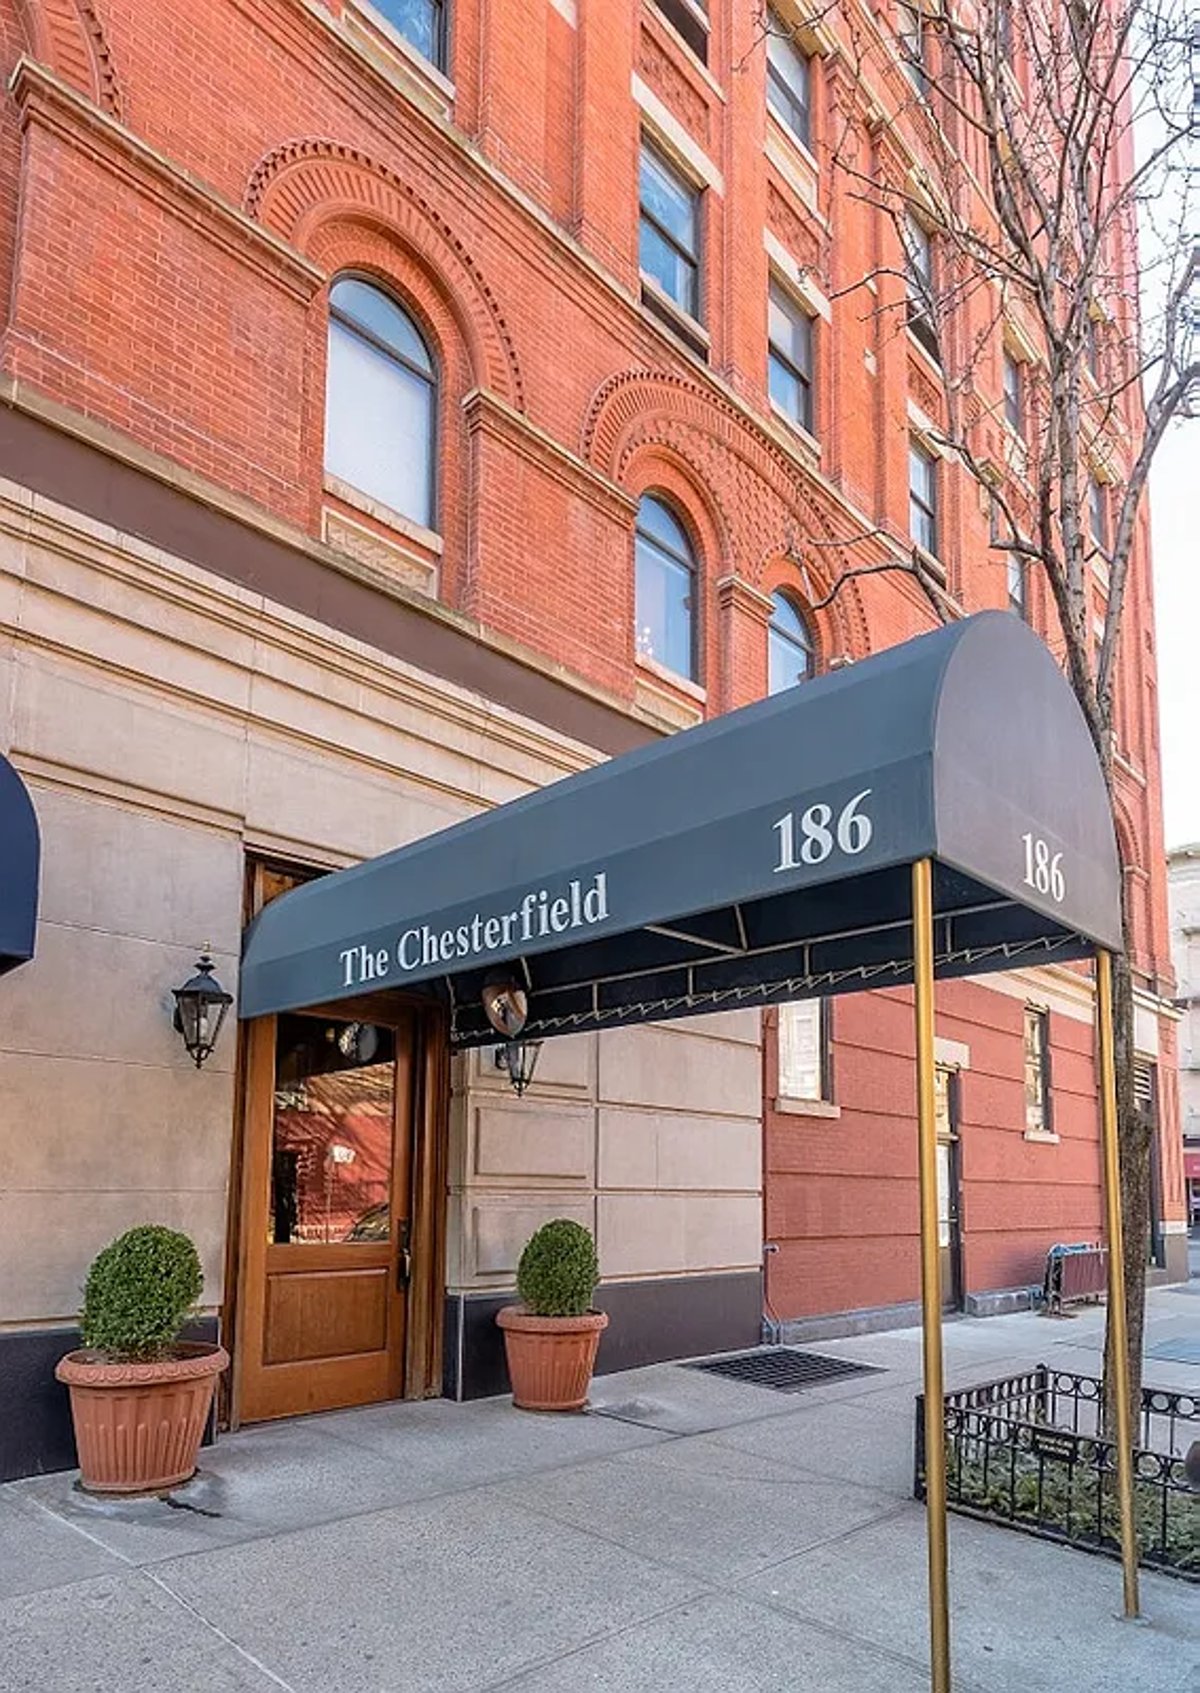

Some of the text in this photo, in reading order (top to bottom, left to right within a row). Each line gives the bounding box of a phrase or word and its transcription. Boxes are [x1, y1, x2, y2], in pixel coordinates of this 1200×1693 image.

[771, 788, 873, 873] 186
[1022, 832, 1065, 902] 186
[339, 872, 610, 987] The Chesterfield
